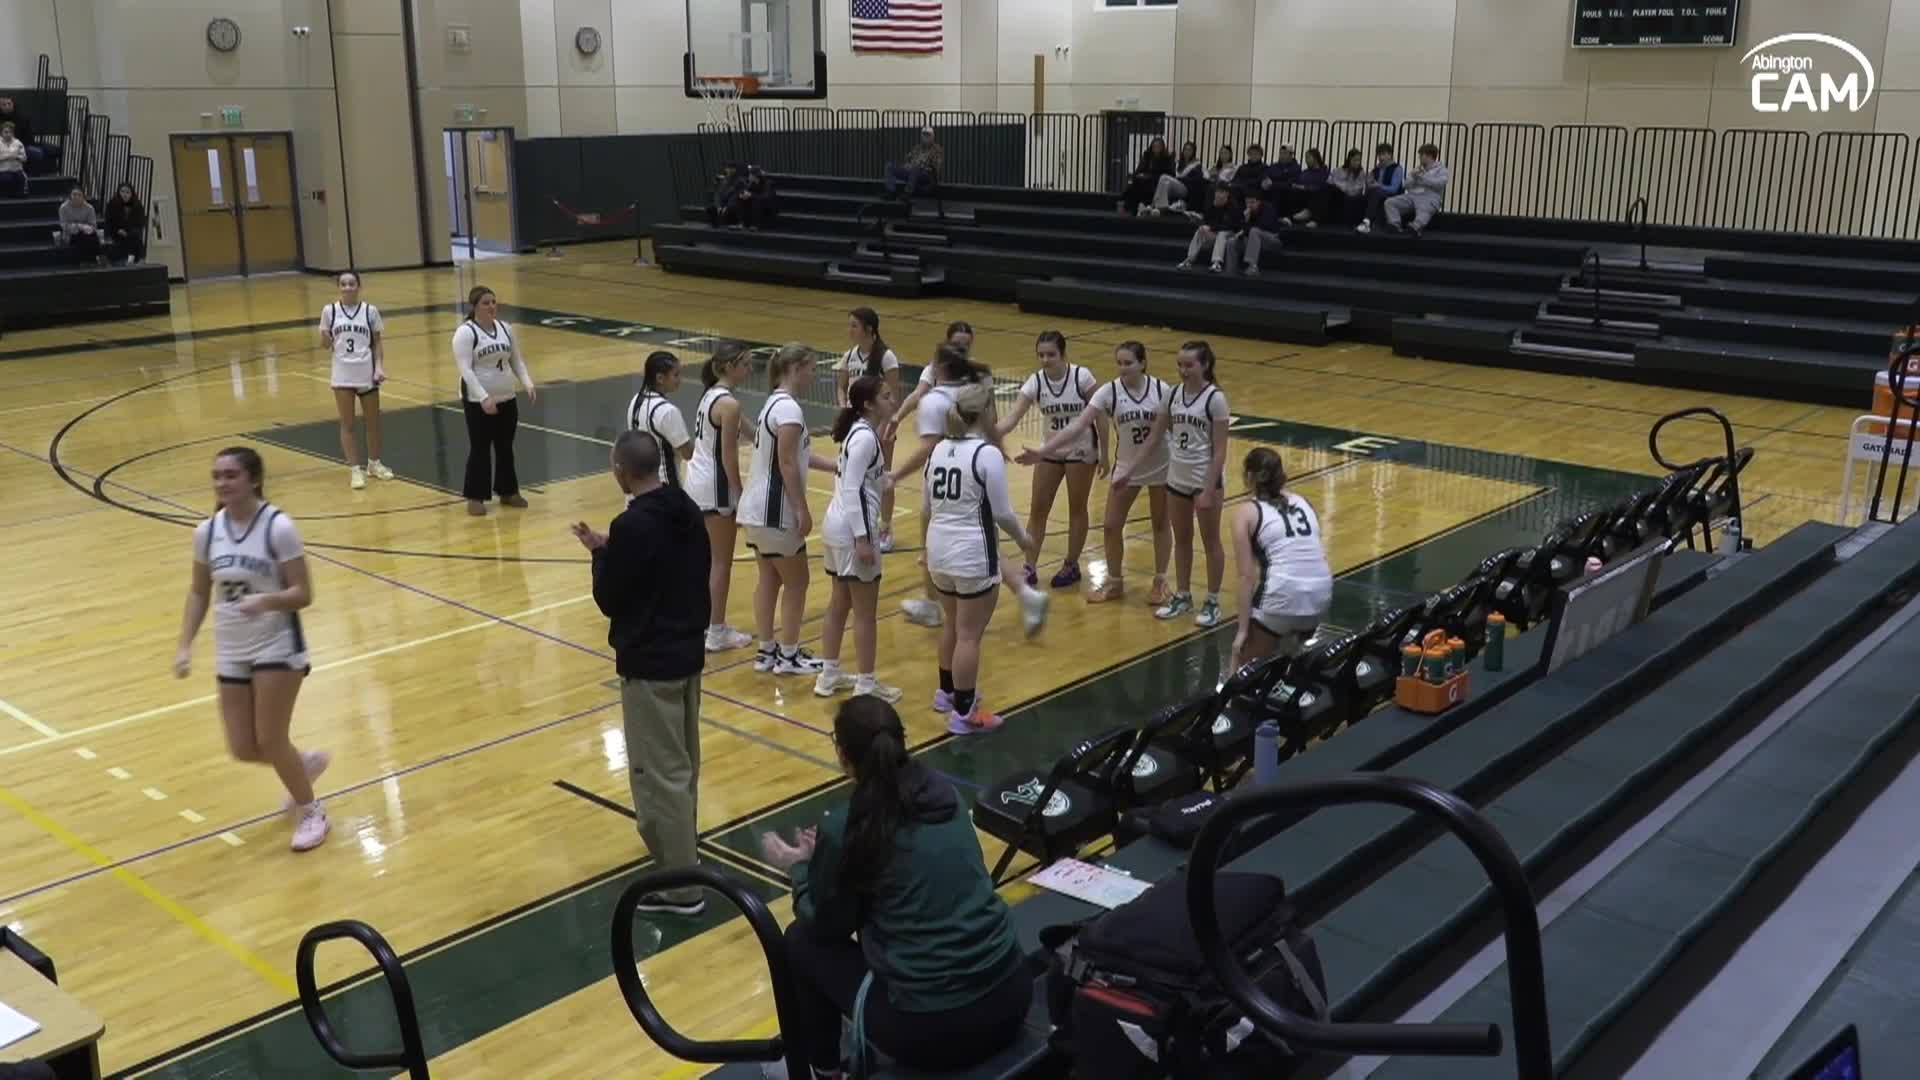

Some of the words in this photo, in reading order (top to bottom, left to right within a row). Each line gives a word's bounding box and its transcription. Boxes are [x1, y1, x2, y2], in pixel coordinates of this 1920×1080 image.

[1632, 8, 1657, 17] PLAYER
[1658, 8, 1675, 17] FOUL
[1580, 36, 1600, 44] SCORE
[1639, 36, 1662, 44] MATCH
[1703, 35, 1724, 43] SCORE
[346, 338, 355, 353] 3
[495, 358, 504, 372] 4
[1179, 431, 1190, 450] 2
[933, 466, 962, 501] 20
[1278, 506, 1312, 538] 13
